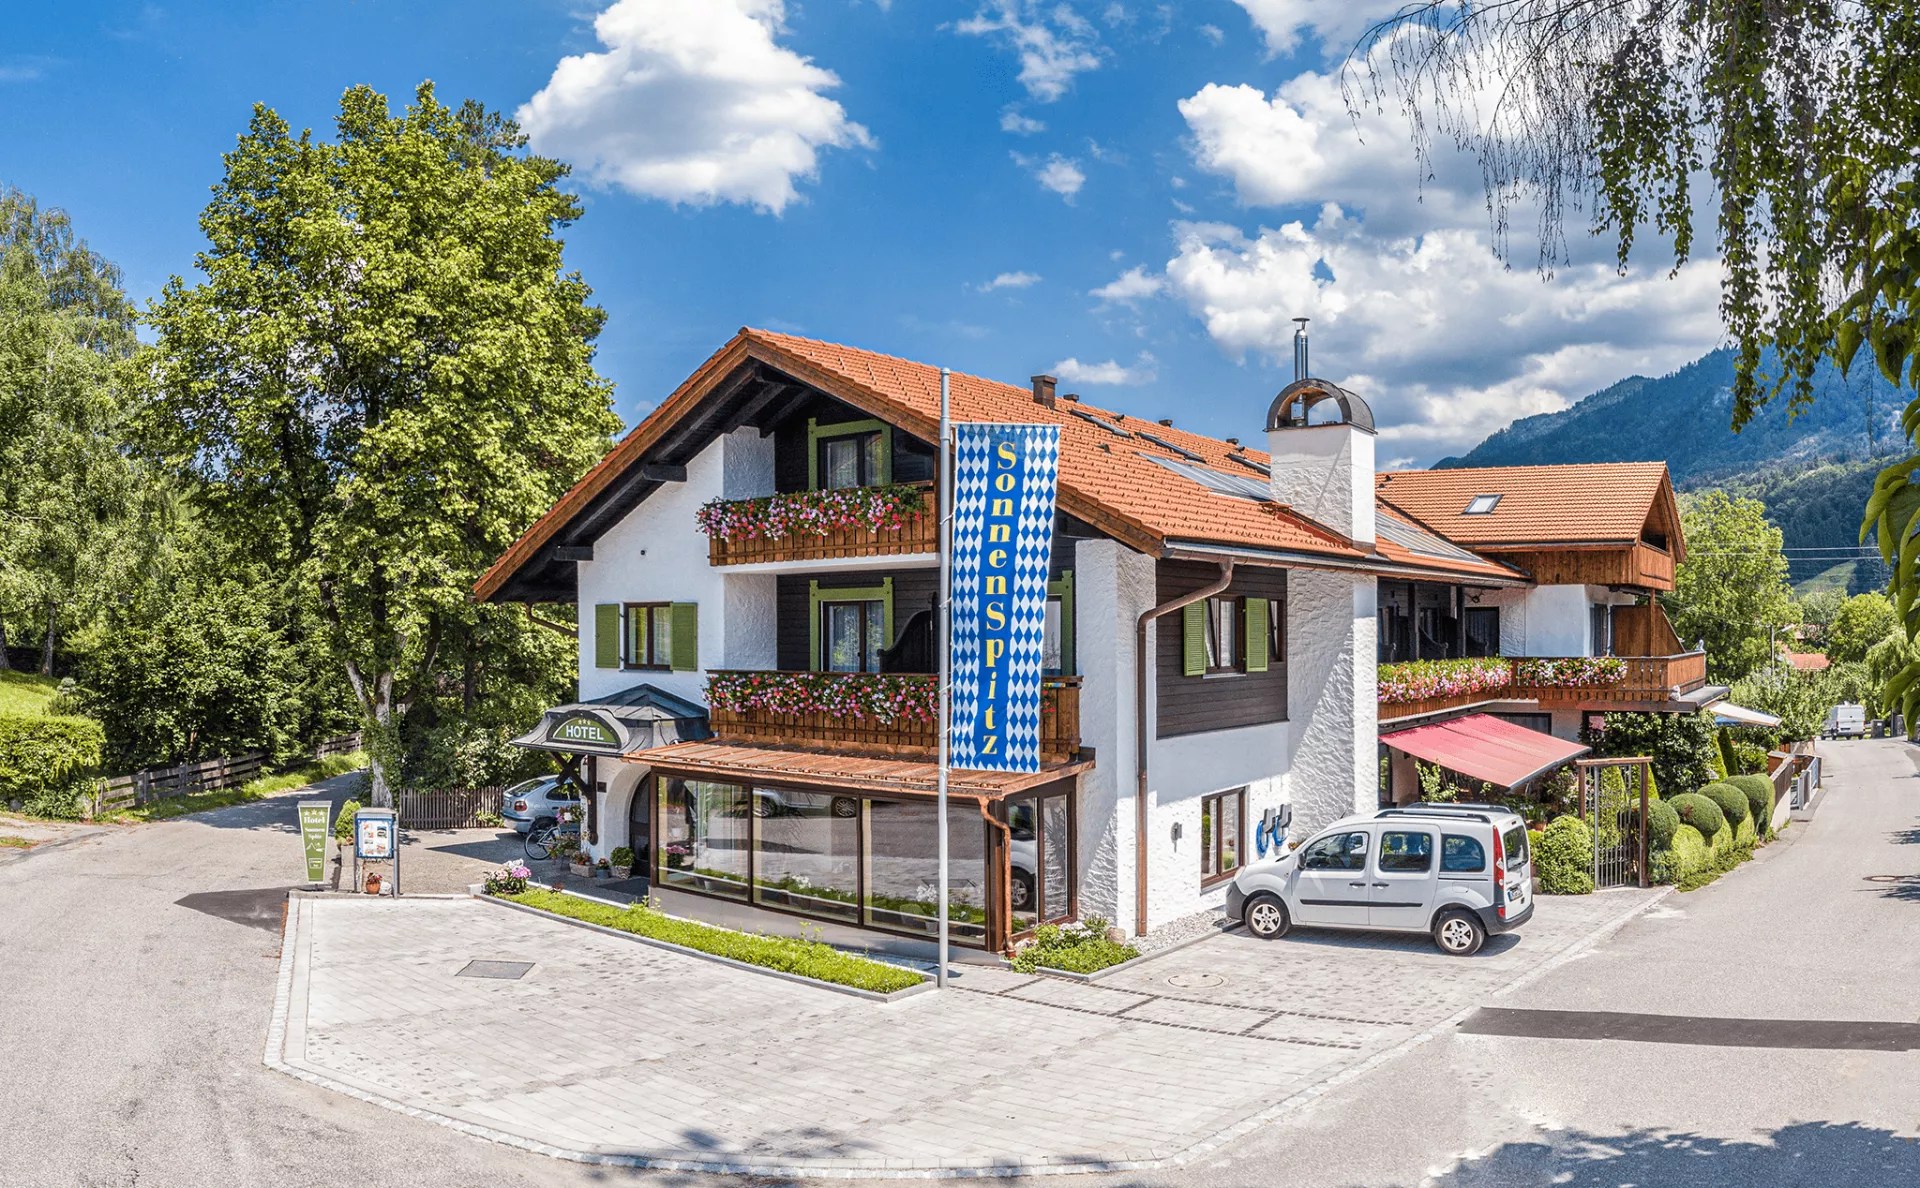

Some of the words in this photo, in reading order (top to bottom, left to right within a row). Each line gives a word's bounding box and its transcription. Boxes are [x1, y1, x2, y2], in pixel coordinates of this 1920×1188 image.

[983, 442, 1016, 755] SonnenSpitz
[566, 725, 604, 741] HOTEL
[304, 816, 325, 824] Hotel
